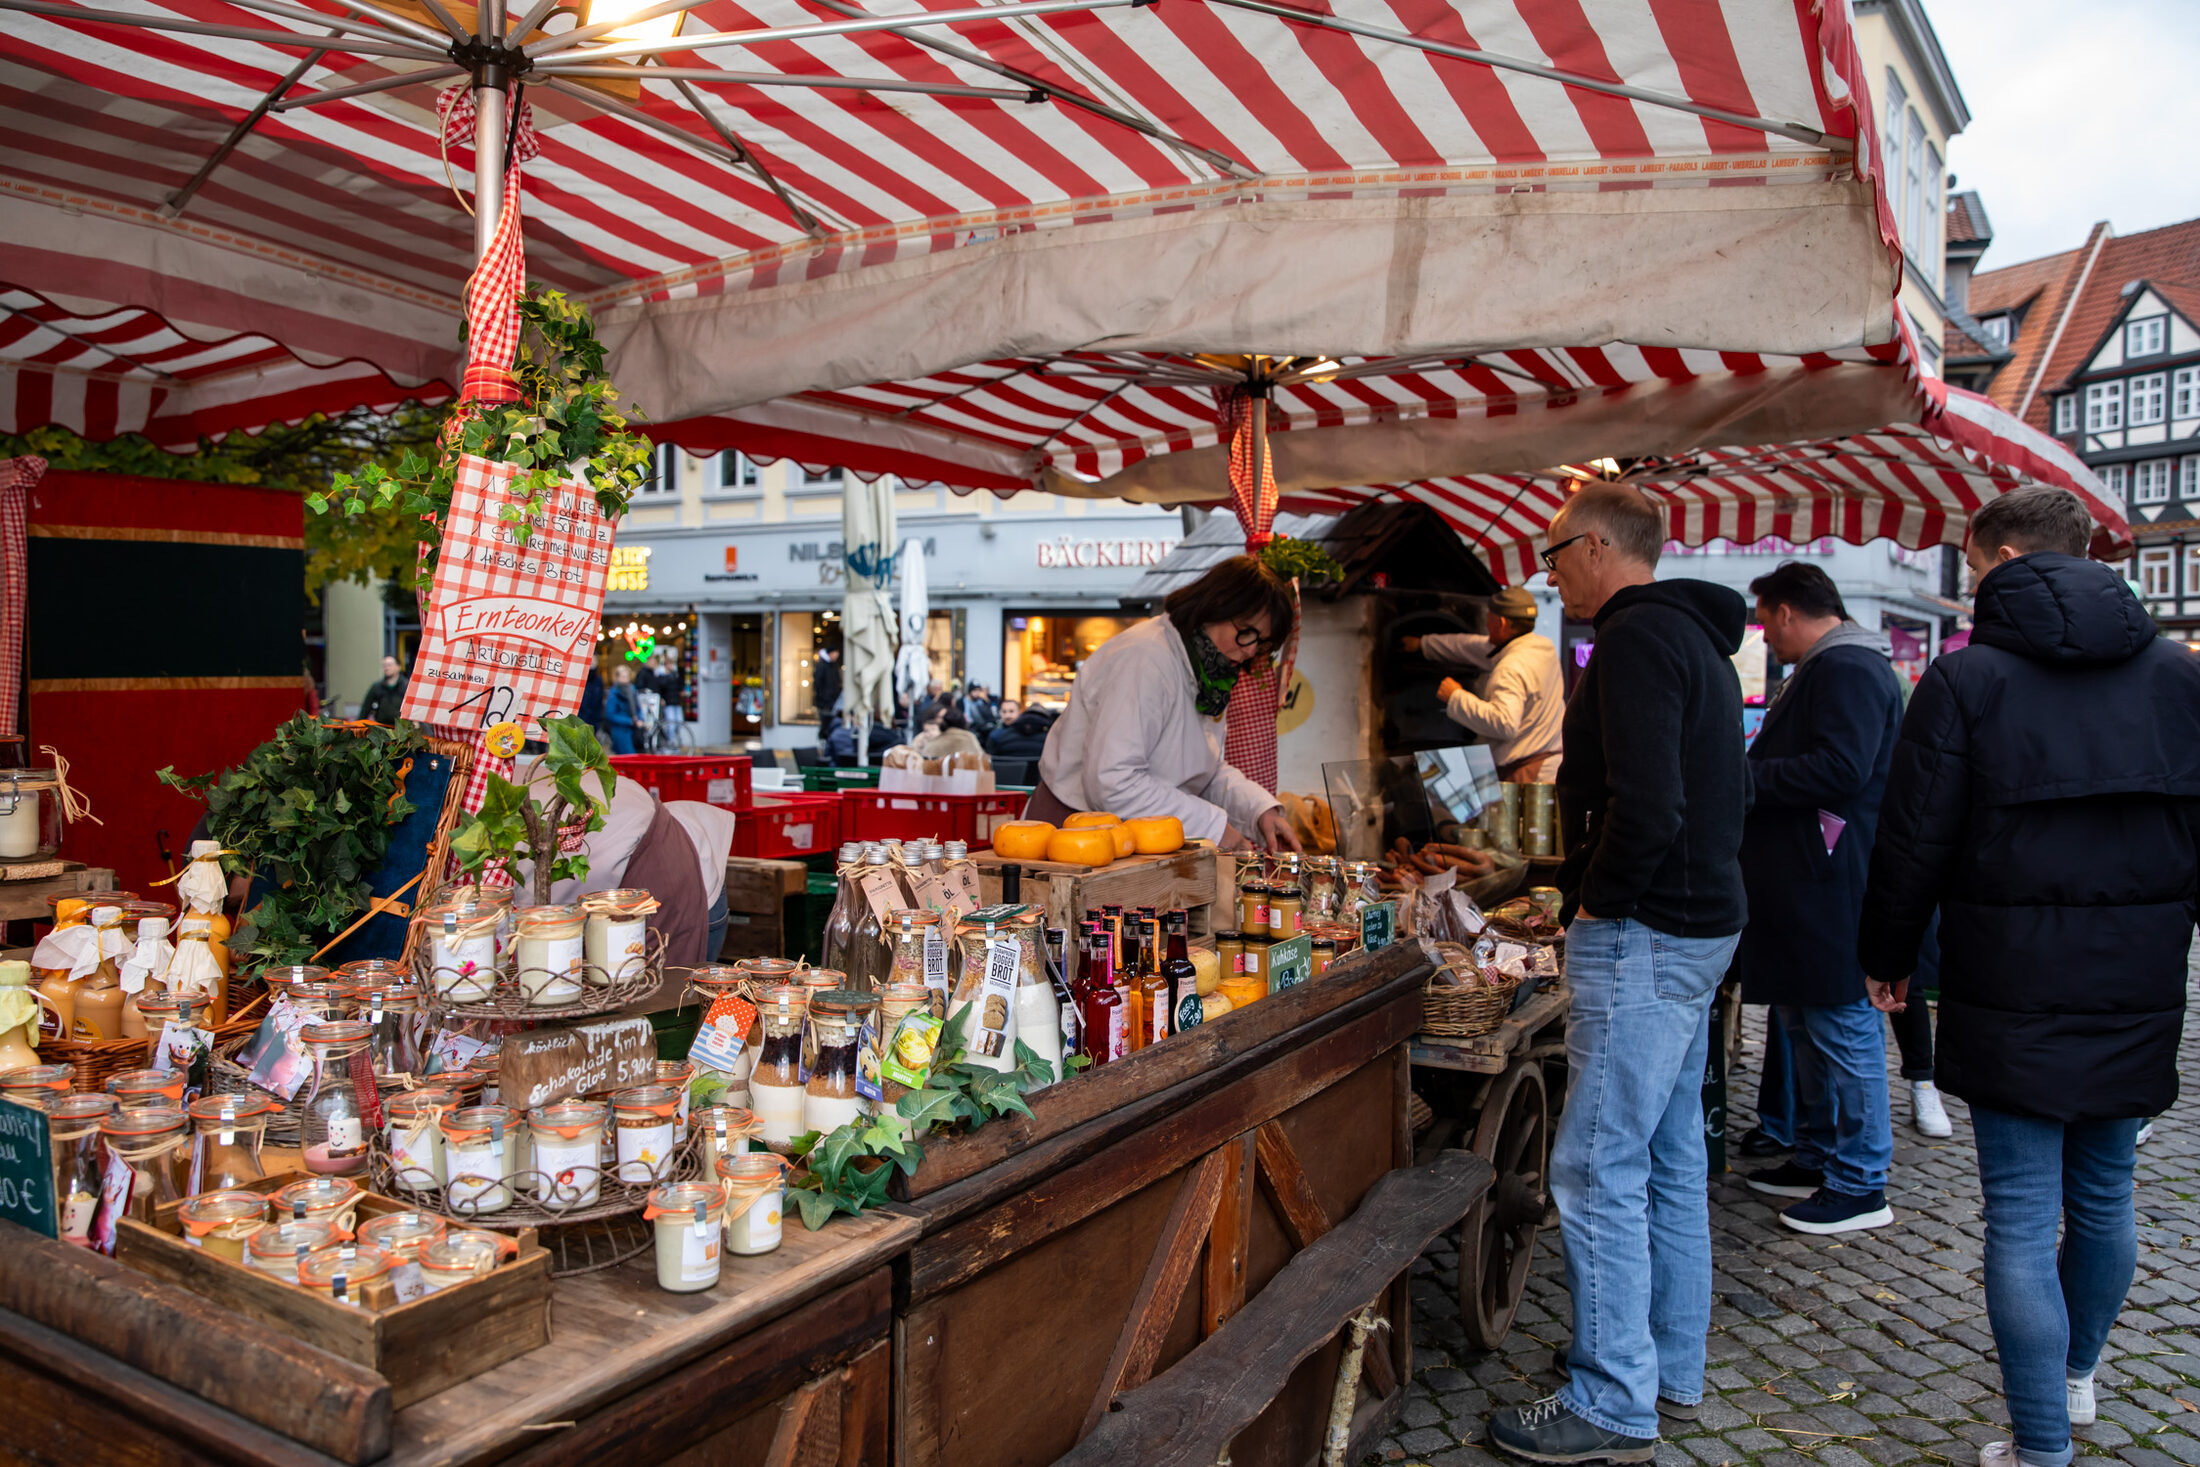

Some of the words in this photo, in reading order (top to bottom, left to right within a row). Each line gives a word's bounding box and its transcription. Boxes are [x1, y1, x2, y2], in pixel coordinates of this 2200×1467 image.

[480, 476, 496, 494] 1
[476, 499, 487, 518] 1
[472, 520, 481, 538] 1
[464, 546, 474, 561] 1
[542, 560, 584, 584] Brot
[455, 604, 586, 638] Ernteonkel
[942, 888, 955, 900] ÖL
[927, 958, 943, 973] BROT
[991, 962, 1014, 982] BROT
[528, 1047, 614, 1106] Schokolade
